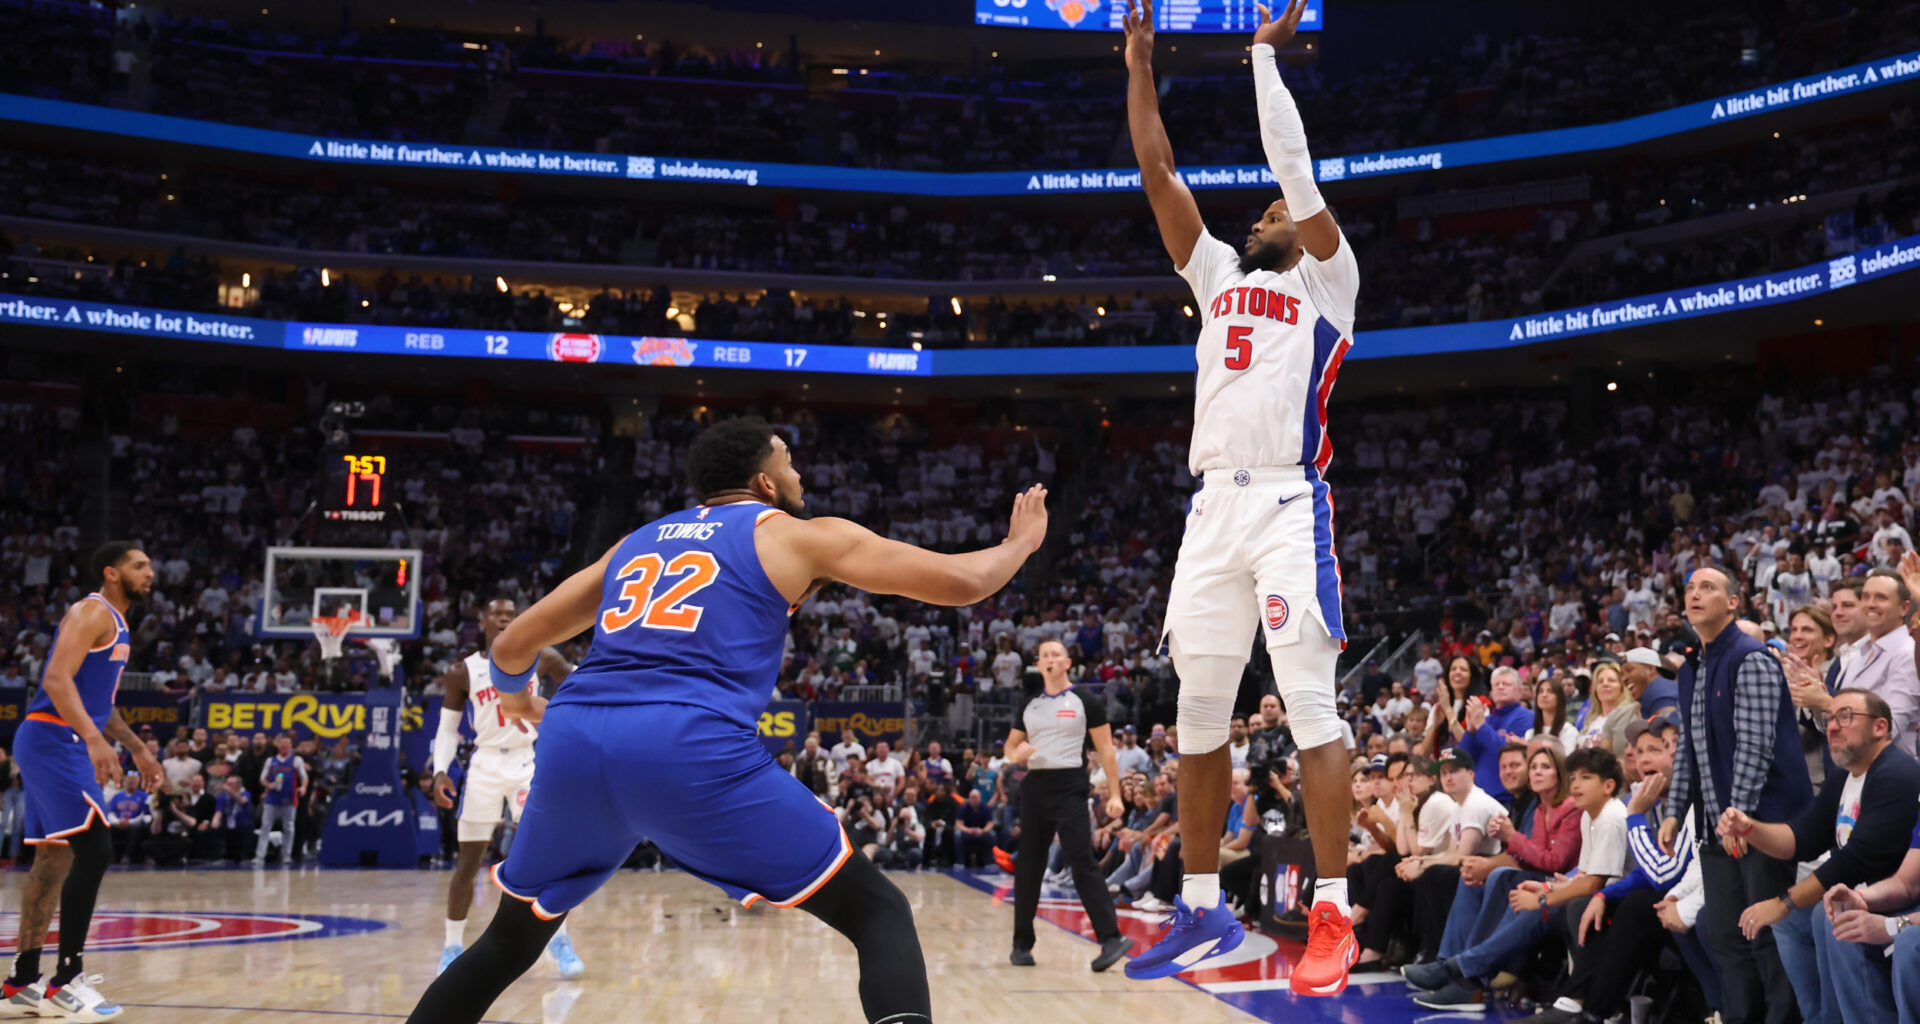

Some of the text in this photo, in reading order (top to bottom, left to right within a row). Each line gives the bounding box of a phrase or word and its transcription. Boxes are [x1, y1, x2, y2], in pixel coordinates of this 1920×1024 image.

[1711, 54, 1920, 119] A little bit further. A who
[309, 141, 758, 186] A little bit further. A whole lot better. toledozoo.org
[1349, 152, 1442, 174] toledozoo.org
[1027, 172, 1141, 190] A little bit furt
[1186, 169, 1236, 185] whole
[1237, 168, 1259, 184] lot
[1509, 323, 1524, 341] A
[1525, 316, 1564, 338] little
[1565, 311, 1589, 331] bit
[1591, 303, 1660, 327] further.
[1662, 297, 1678, 315] A
[1679, 287, 1736, 312] whole
[1737, 284, 1763, 303] lot
[1765, 273, 1823, 298] better.
[1861, 245, 1920, 275] toledozo
[1211, 286, 1301, 325] PISTONS
[0, 300, 255, 340] rther. A whole lot better.
[405, 333, 509, 354] REB 12
[1224, 325, 1254, 370] 5
[714, 346, 807, 367] REB 17
[343, 455, 386, 475] 7:57
[346, 473, 381, 506] 17
[341, 510, 386, 521] TISSOT
[656, 522, 723, 542] TOWNS
[600, 550, 721, 635] 32
[355, 782, 392, 797] Google
